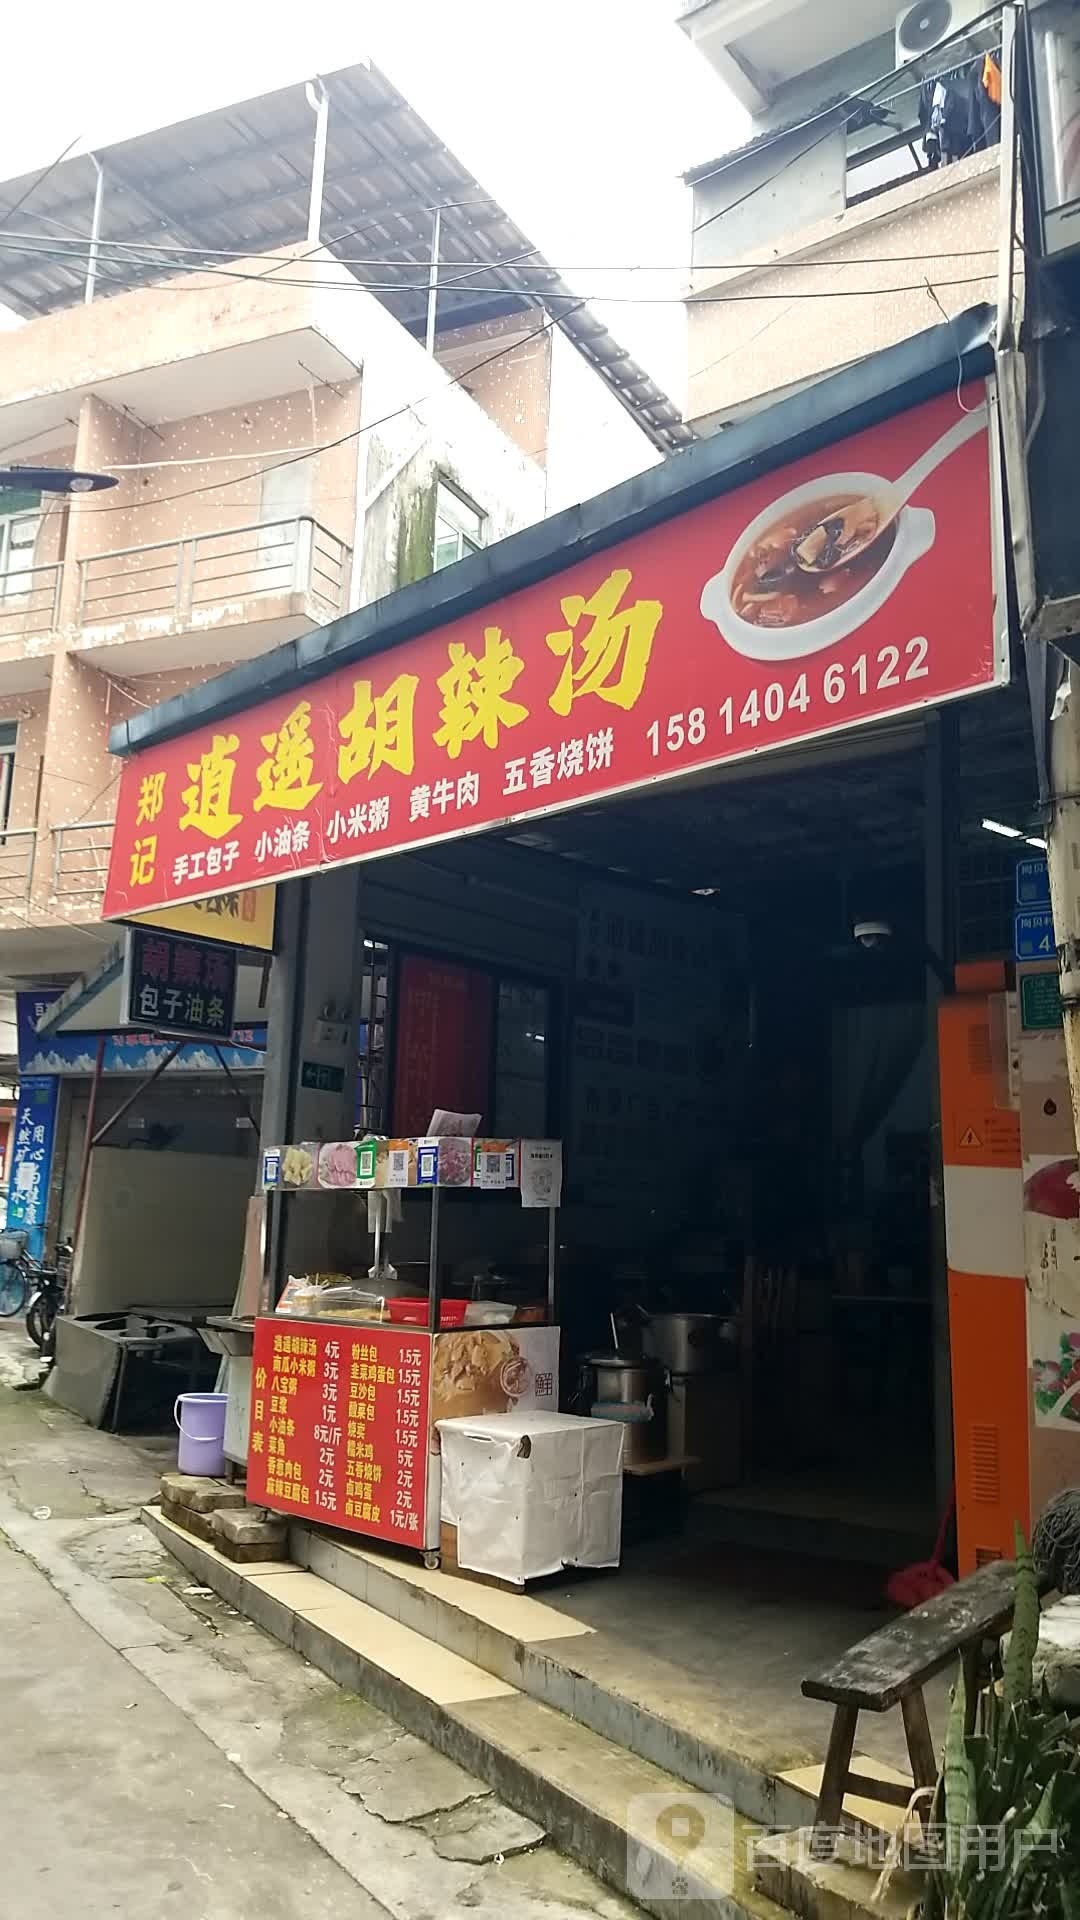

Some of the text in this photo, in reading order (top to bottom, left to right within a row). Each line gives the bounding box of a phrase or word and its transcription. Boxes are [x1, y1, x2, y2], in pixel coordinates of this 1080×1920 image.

[178, 568, 663, 840] 逍遥胡辣汤
[172, 634, 930, 887] 手工包子 小油条 小米粥 黄牛肉 五香烧饼 158 1404 6122
[128, 771, 165, 888] 郑记
[139, 984, 225, 1027] 包子油条
[11, 1107, 34, 1205] 天然矿水
[273, 1335, 340, 1359] 逍遥胡辣汤 4元
[351, 1343, 422, 1366] 粉丝包 1.5元
[272, 1355, 339, 1380] 南瓜小米粥 3元
[398, 1368, 421, 1387] 1.5元
[271, 1375, 338, 1402] 八宝粥 3元
[349, 1382, 420, 1407] 豆沙包 1.5元
[535, 1372, 553, 1397] 鮮
[251, 1367, 267, 1454] 价目表
[270, 1395, 336, 1424] 豆浆 1元
[396, 1409, 419, 1428] 1.5元
[269, 1415, 342, 1446] 小油条 8元/斤
[347, 1420, 418, 1448] 烧卖 1.5元
[267, 1436, 335, 1466] 菜角 2元
[346, 1439, 414, 1468] 糯米鸡 5元
[267, 1457, 334, 1488] 香葱肉包 2元
[345, 1459, 413, 1489] 五香烧饼 2元
[266, 1477, 337, 1511] 麻辣豆腐包 1.5元
[345, 1478, 413, 1509] 卤鸡蛋 2元
[345, 1499, 419, 1531] 卤豆腐皮 1元/张
